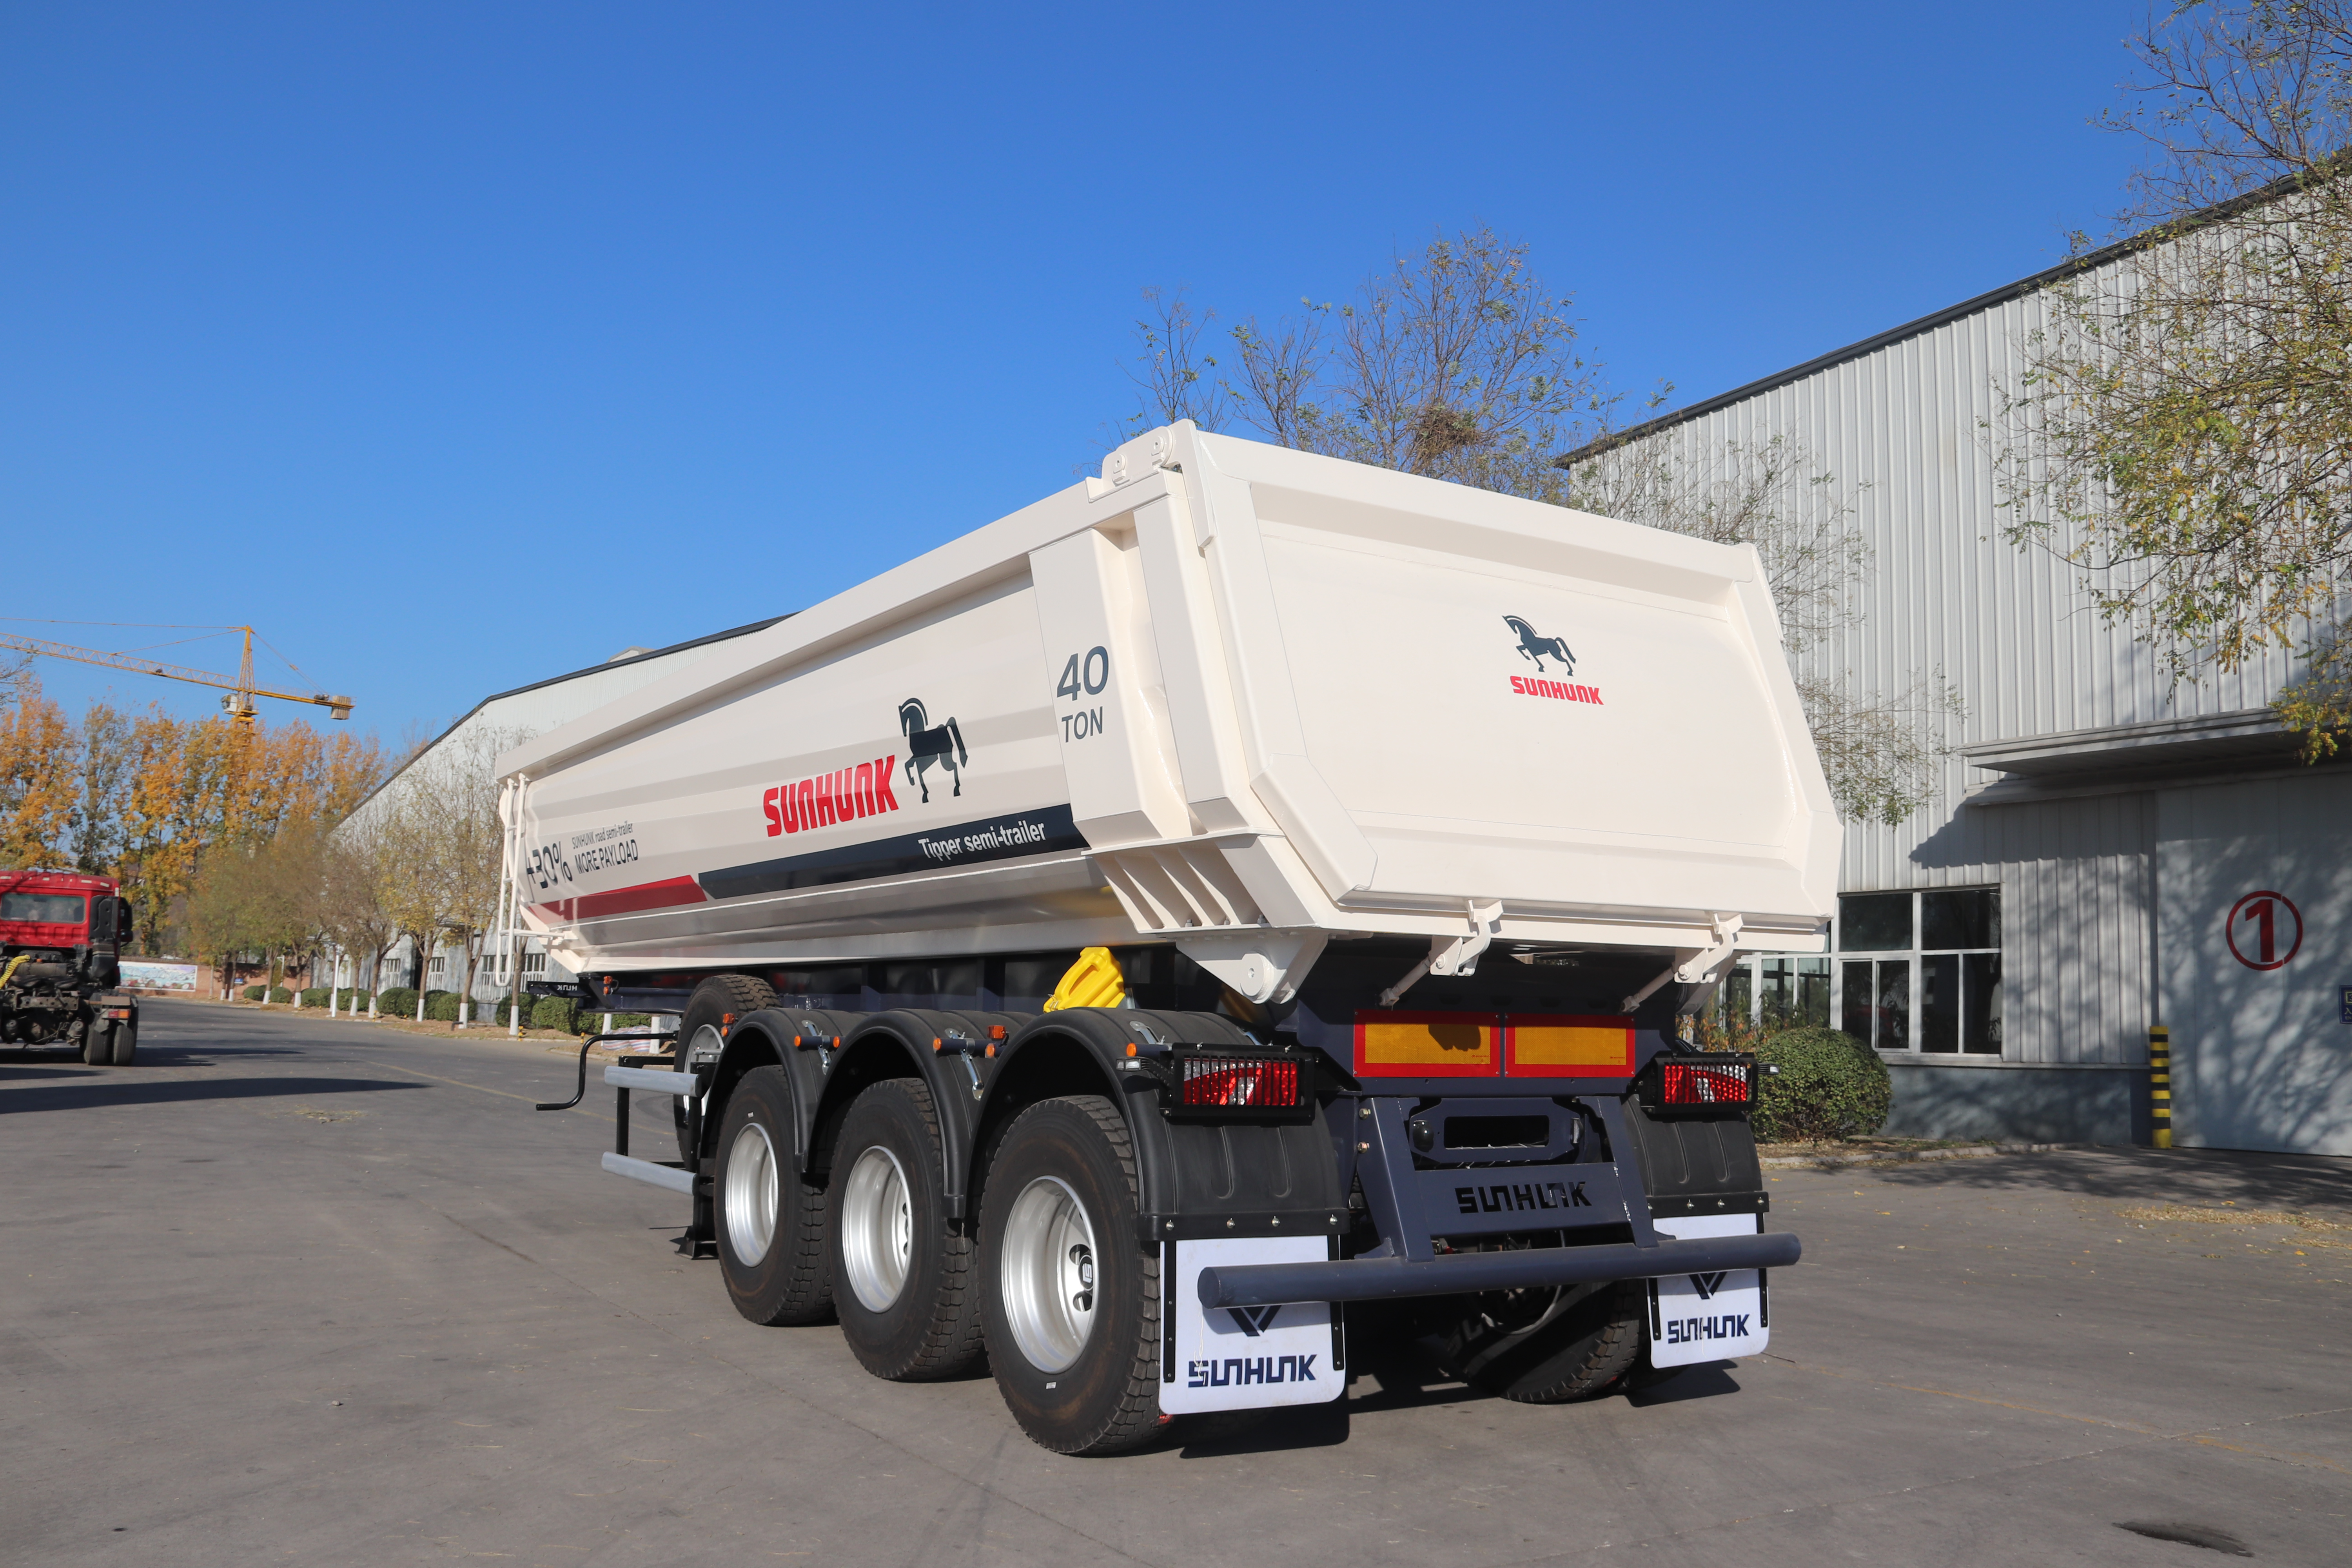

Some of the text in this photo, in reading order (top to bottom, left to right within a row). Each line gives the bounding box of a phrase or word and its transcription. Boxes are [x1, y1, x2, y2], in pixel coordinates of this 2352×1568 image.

[1057, 646, 1109, 701] 40
[1510, 676, 1603, 705] SUNHUNK
[1062, 706, 1103, 743] TON
[764, 755, 898, 837] SUNHUNK
[572, 820, 633, 849] SUNHUNK road semi-trailer
[918, 820, 1046, 861] Tipper semi-trailer
[527, 841, 573, 889] +30%
[575, 839, 638, 874] MORE PAYLOAD
[1455, 1181, 1592, 1214] SUNHUNK
[1668, 1314, 1749, 1344] SUNHUNK
[1188, 1354, 1317, 1388] SUNHUNK
